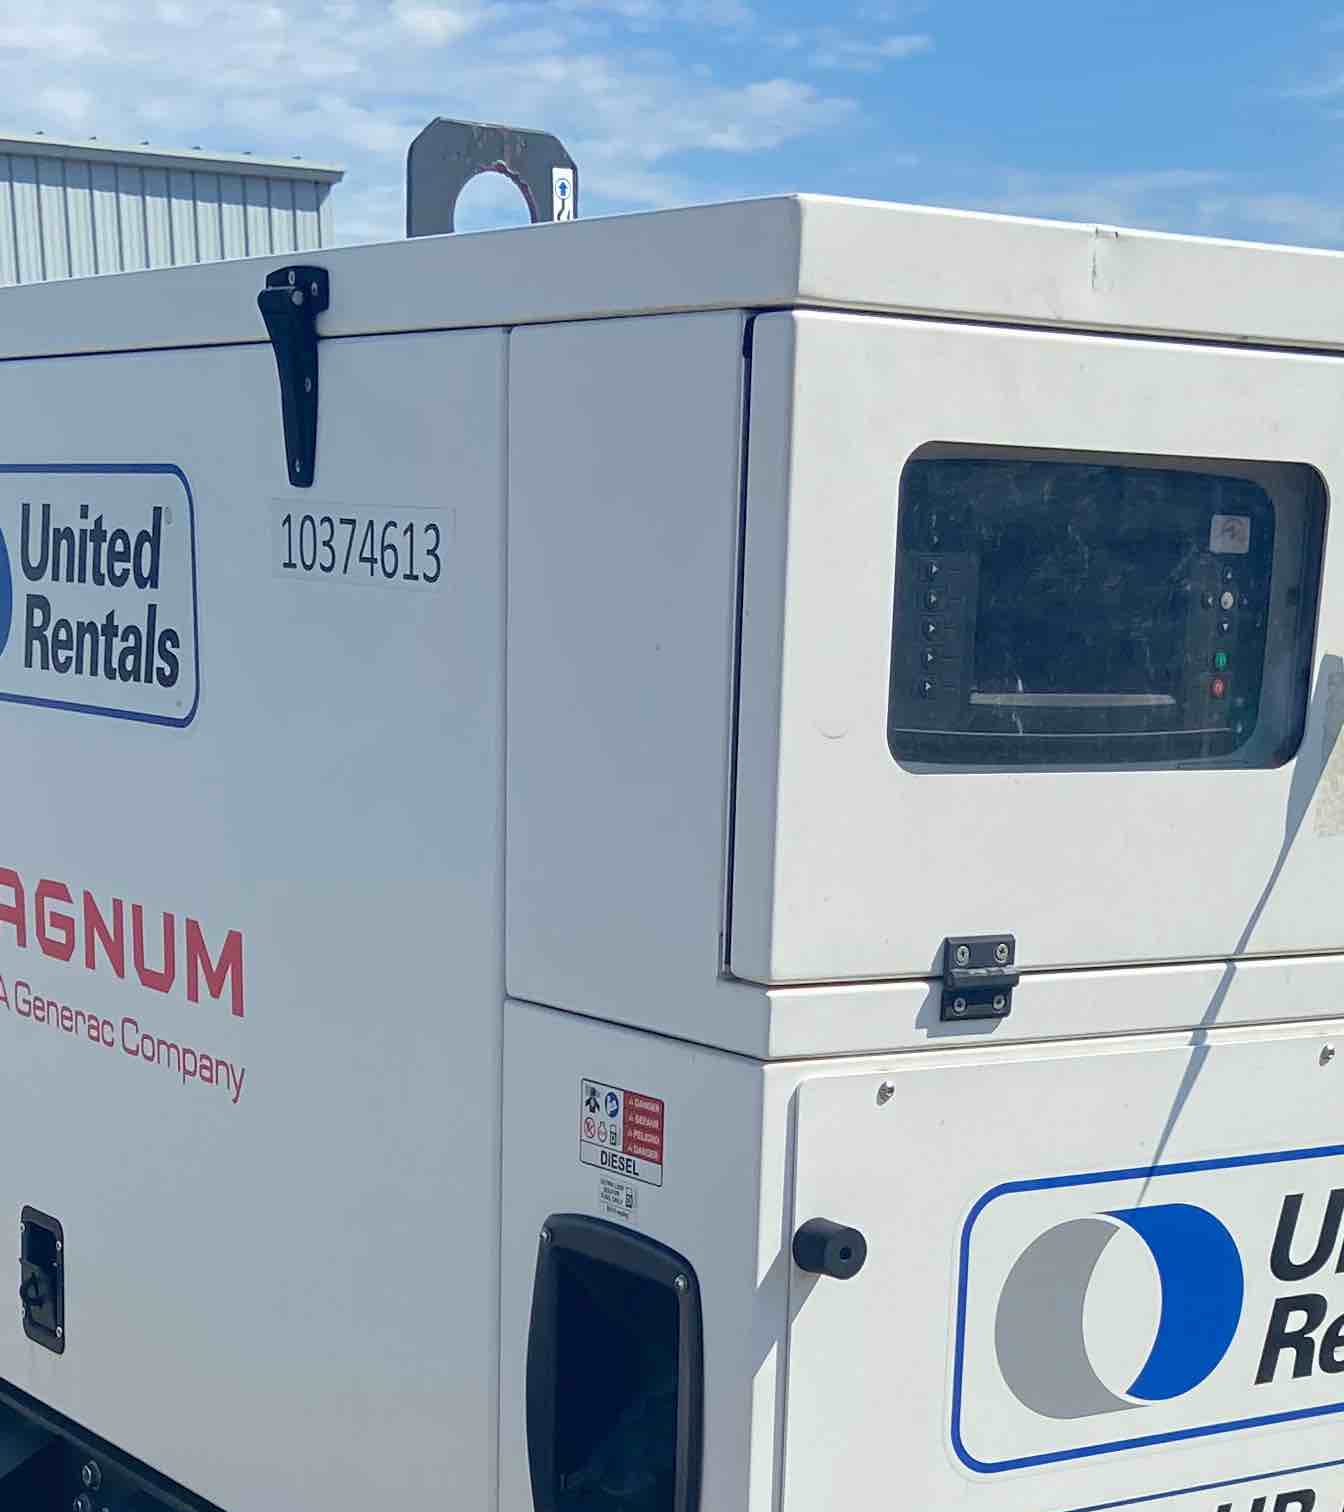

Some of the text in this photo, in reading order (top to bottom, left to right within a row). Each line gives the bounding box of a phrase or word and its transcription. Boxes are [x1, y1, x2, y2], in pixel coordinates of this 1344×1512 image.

[20, 503, 163, 589] United
[282, 513, 441, 583] 10374613
[24, 593, 180, 688] Rentals
[14, 980, 114, 1048] Generac
[121, 1017, 245, 1105] Company
[600, 1150, 639, 1176] DIESEL
